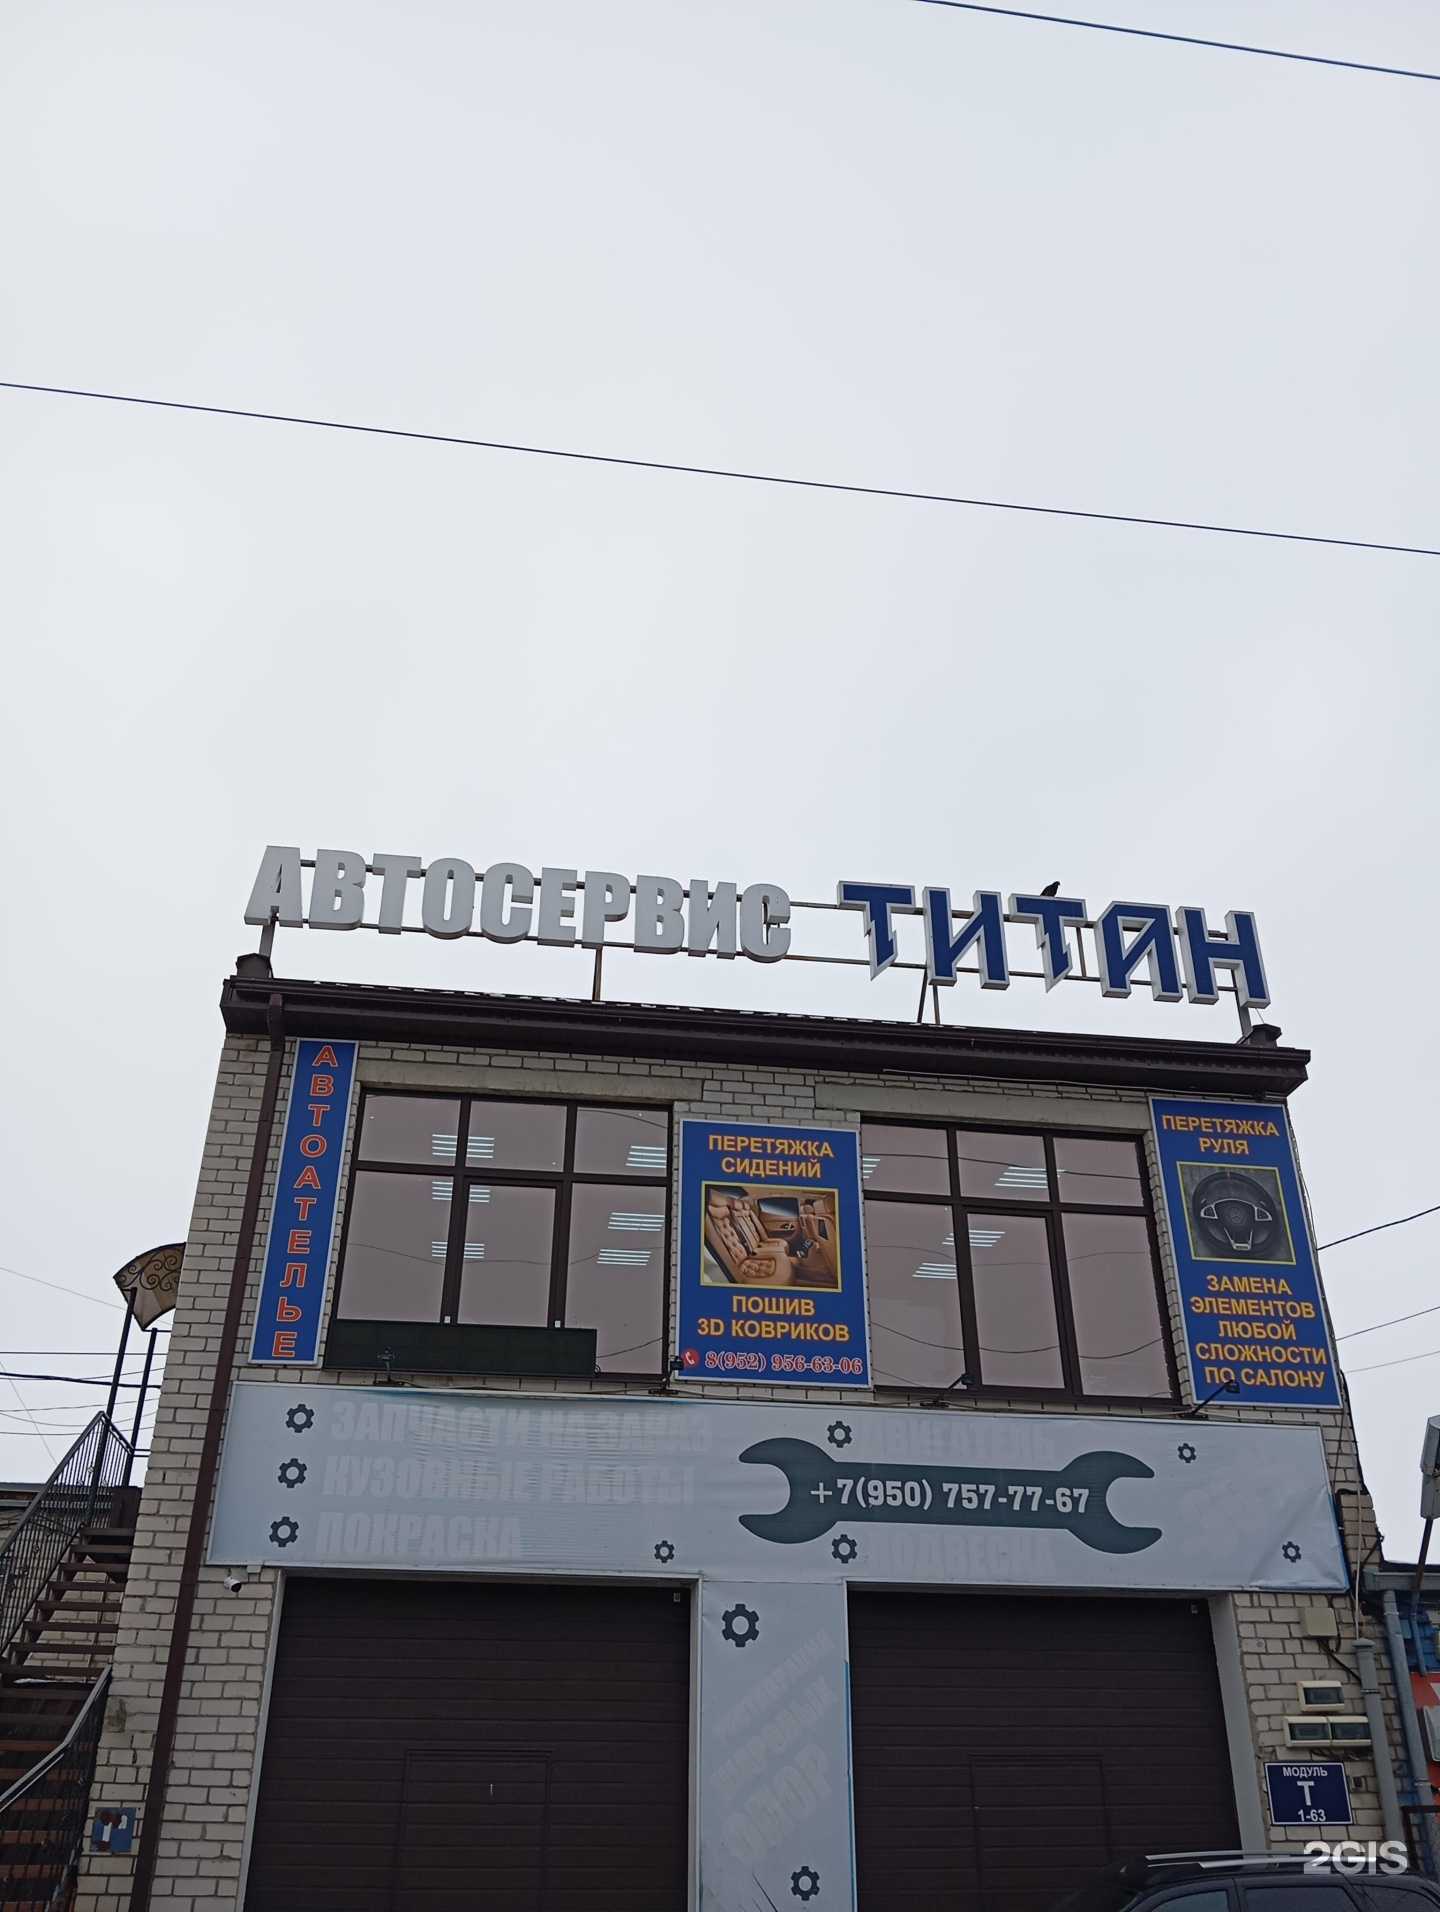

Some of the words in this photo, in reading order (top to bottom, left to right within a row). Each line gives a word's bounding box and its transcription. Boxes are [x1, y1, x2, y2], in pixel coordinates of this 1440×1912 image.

[244, 845, 791, 963] АВТОСЕРВИС
[837, 881, 1271, 1008] ТИТАН
[1162, 1114, 1280, 1137] ПЕРЕТЯЖКА
[708, 1135, 834, 1158] ПЕРЕТЯЖКА
[1199, 1137, 1249, 1154] РУЛЯ
[721, 1157, 822, 1178] СИДЕНИЙ
[271, 1045, 338, 1358] АВТОАТЕЛЬЕ
[1206, 1275, 1292, 1295] ЗАМЕНА
[732, 1295, 815, 1316] ПОШИВ
[1191, 1296, 1316, 1318] ЭЛЕМЕНТОВ
[697, 1318, 724, 1336] 3D
[731, 1319, 850, 1342] КОВРИКОВ
[1218, 1319, 1297, 1340] ЛЮБОЙ
[704, 1351, 767, 1373] 8(952)
[771, 1354, 863, 1375] 956-63-06
[1195, 1343, 1327, 1365] СЛОЖНОСТИ
[1205, 1366, 1236, 1386] ПО
[1241, 1368, 1326, 1389] САЛОНУ
[942, 1482, 1090, 1513] 757-77-67
[315, 1512, 521, 1560] ПОКРАСКА
[1282, 1766, 1328, 1779] МОДУЛЬ
[1297, 1780, 1315, 1806] Т
[1297, 1809, 1327, 1822] 1-63
